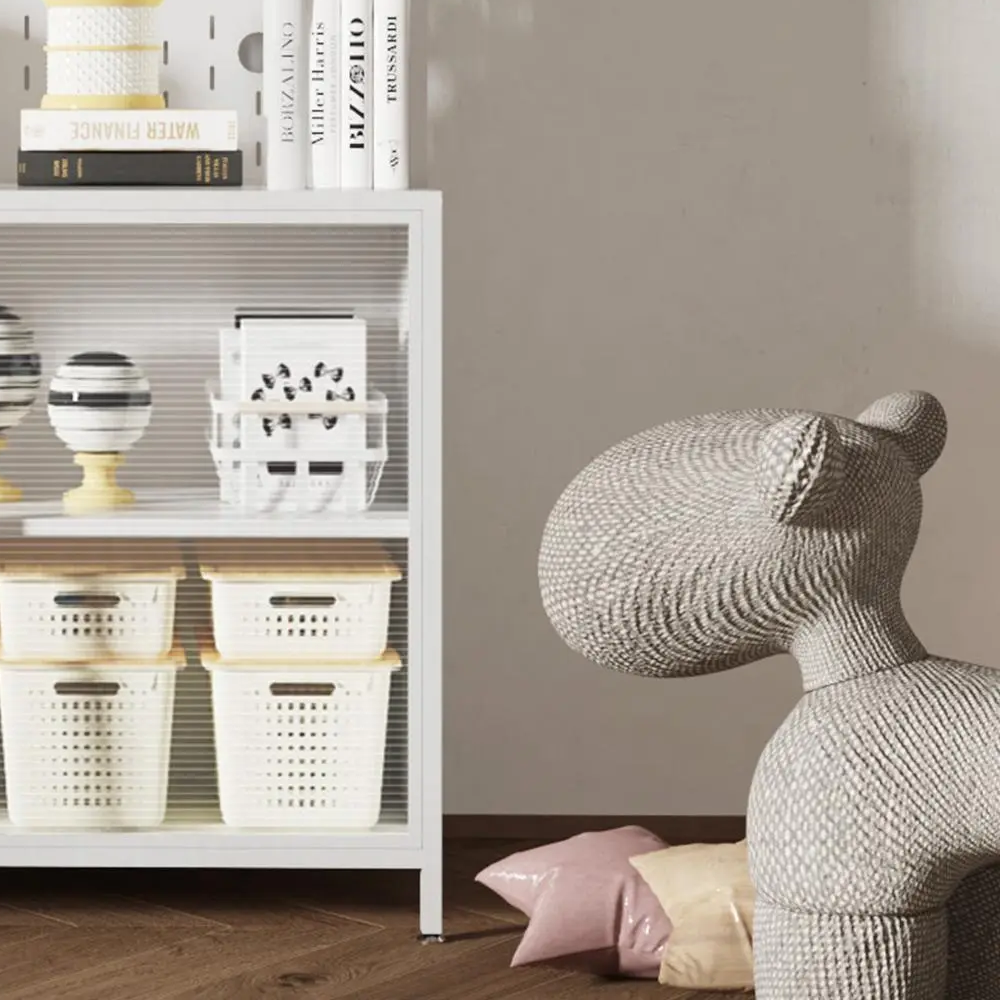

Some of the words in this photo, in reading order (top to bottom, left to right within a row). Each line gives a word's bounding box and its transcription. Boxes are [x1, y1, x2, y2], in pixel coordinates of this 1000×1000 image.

[311, 21, 325, 82] Harris
[386, 15, 398, 104] TRUSSARDI
[280, 21, 296, 143] BORZALINO
[70, 120, 140, 139] FINANCE
[147, 121, 200, 139] WATER
[311, 88, 325, 145] Miller
